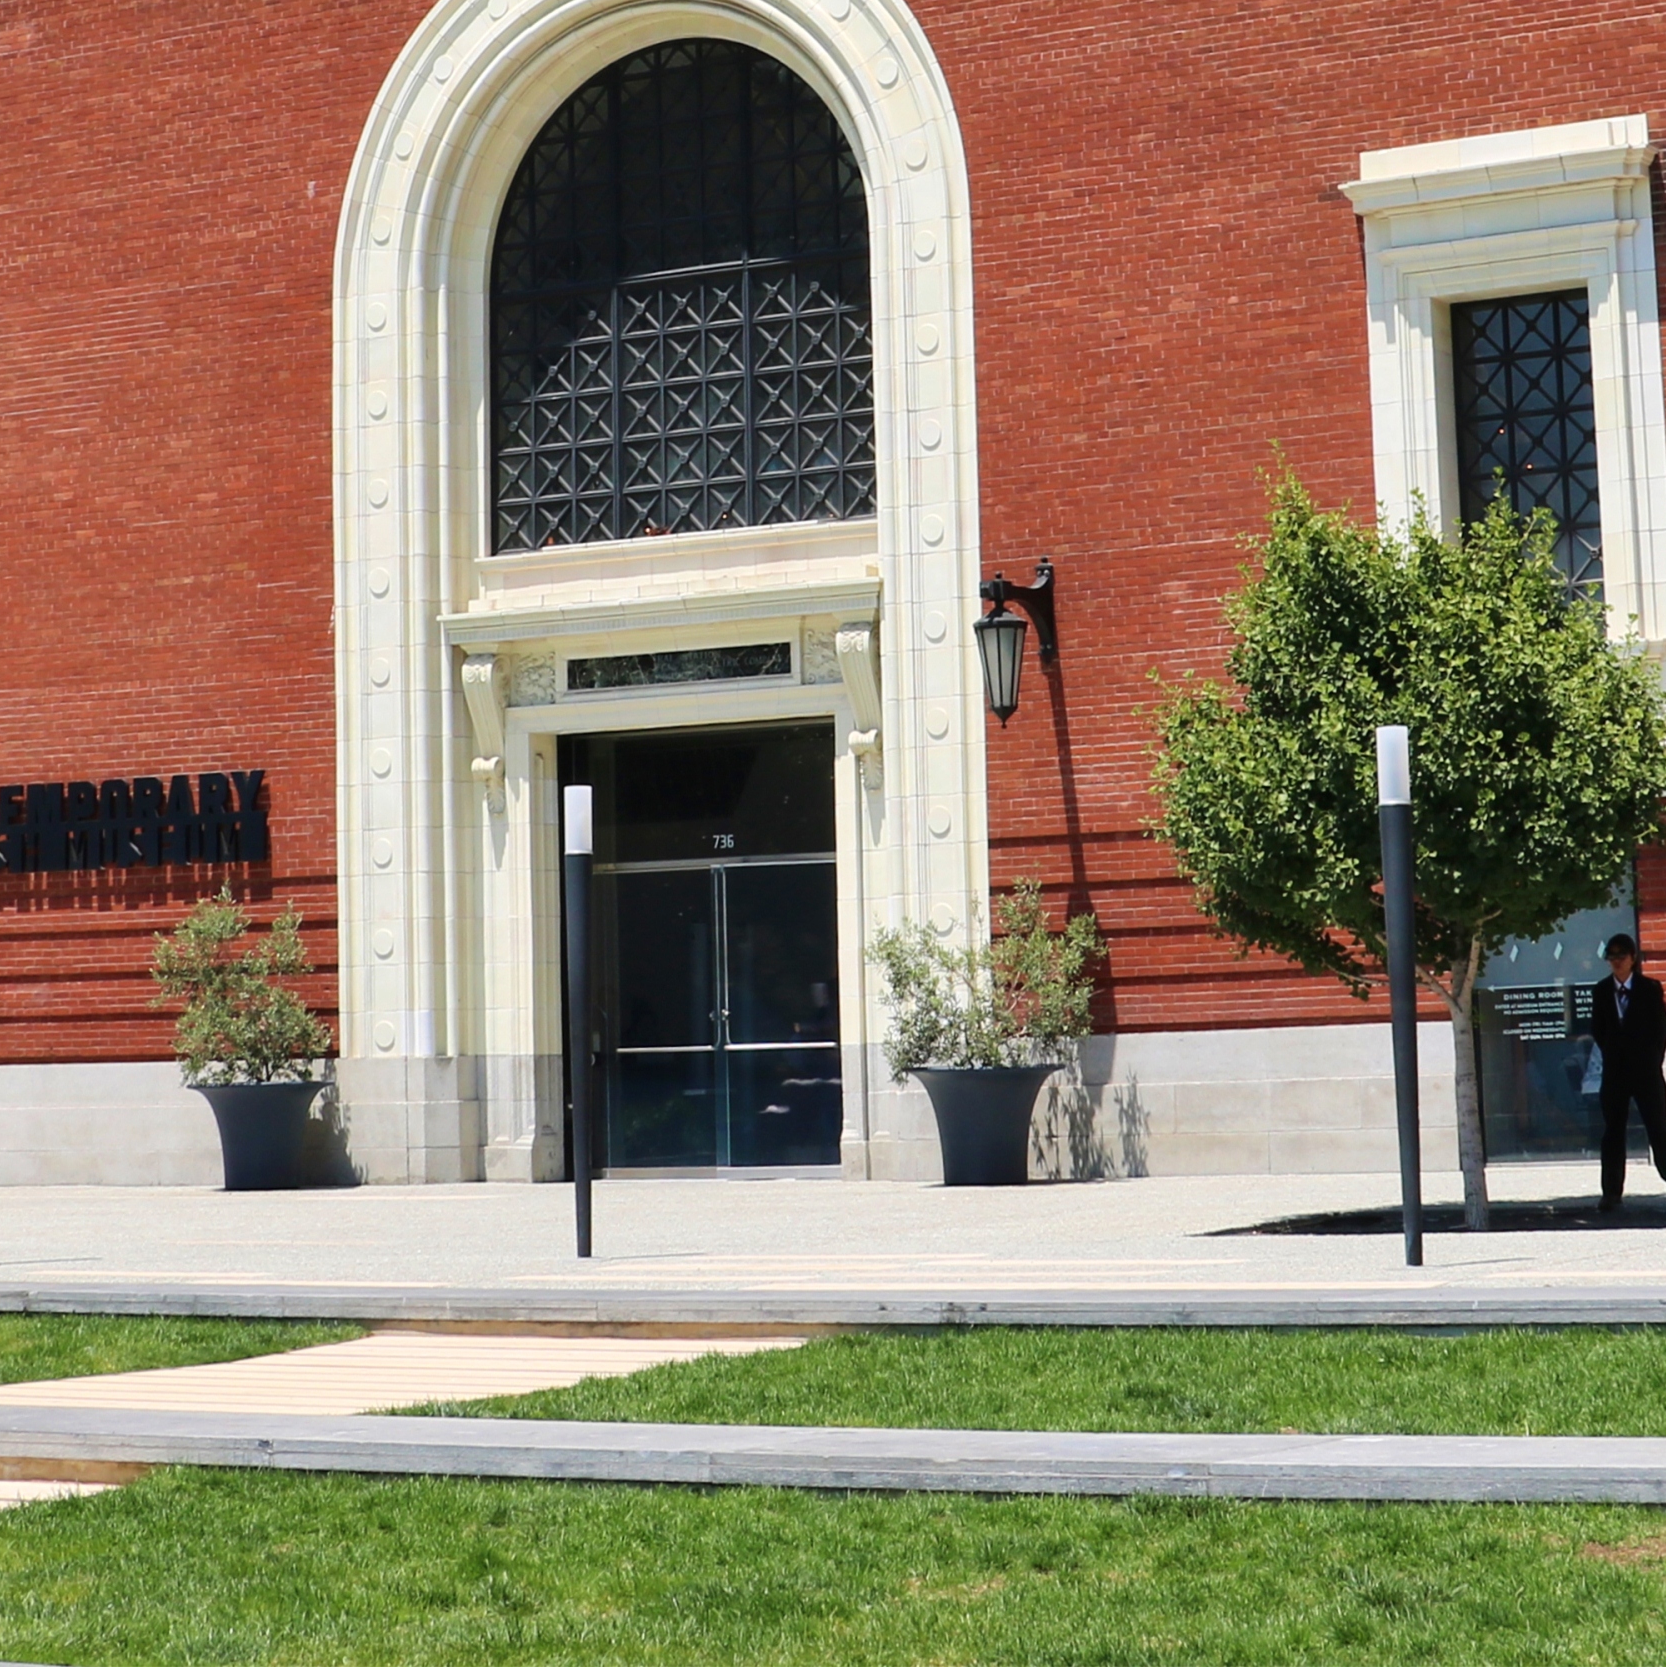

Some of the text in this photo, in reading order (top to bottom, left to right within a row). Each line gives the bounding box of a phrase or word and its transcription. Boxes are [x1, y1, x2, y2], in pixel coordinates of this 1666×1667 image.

[713, 834, 734, 849] 736
[1503, 991, 1564, 1001] DINING ROOM
